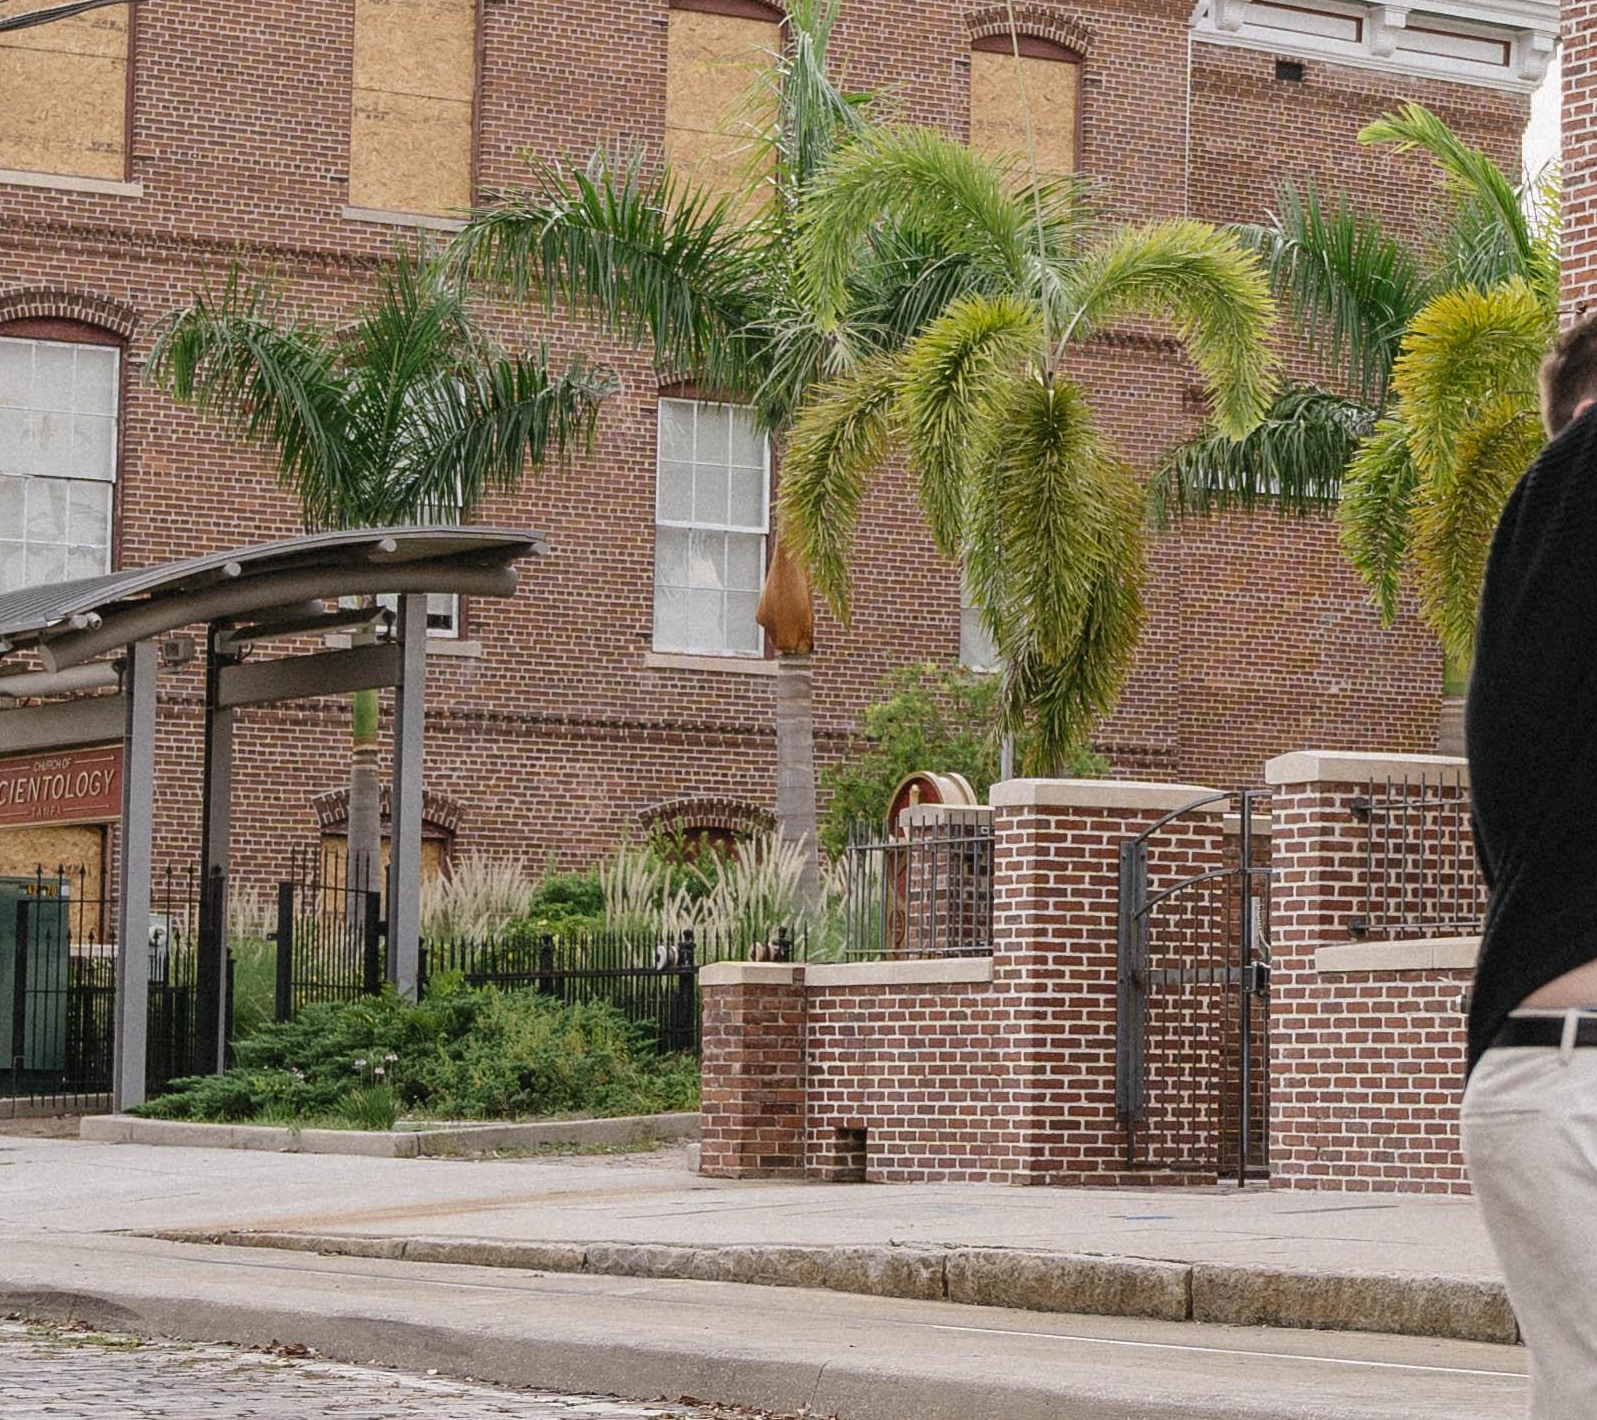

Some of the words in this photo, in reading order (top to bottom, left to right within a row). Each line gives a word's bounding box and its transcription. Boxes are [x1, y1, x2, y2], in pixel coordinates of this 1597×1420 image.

[33, 759, 61, 772] CHURCH
[62, 757, 72, 769] OF
[31, 805, 62, 819] TAMPA
